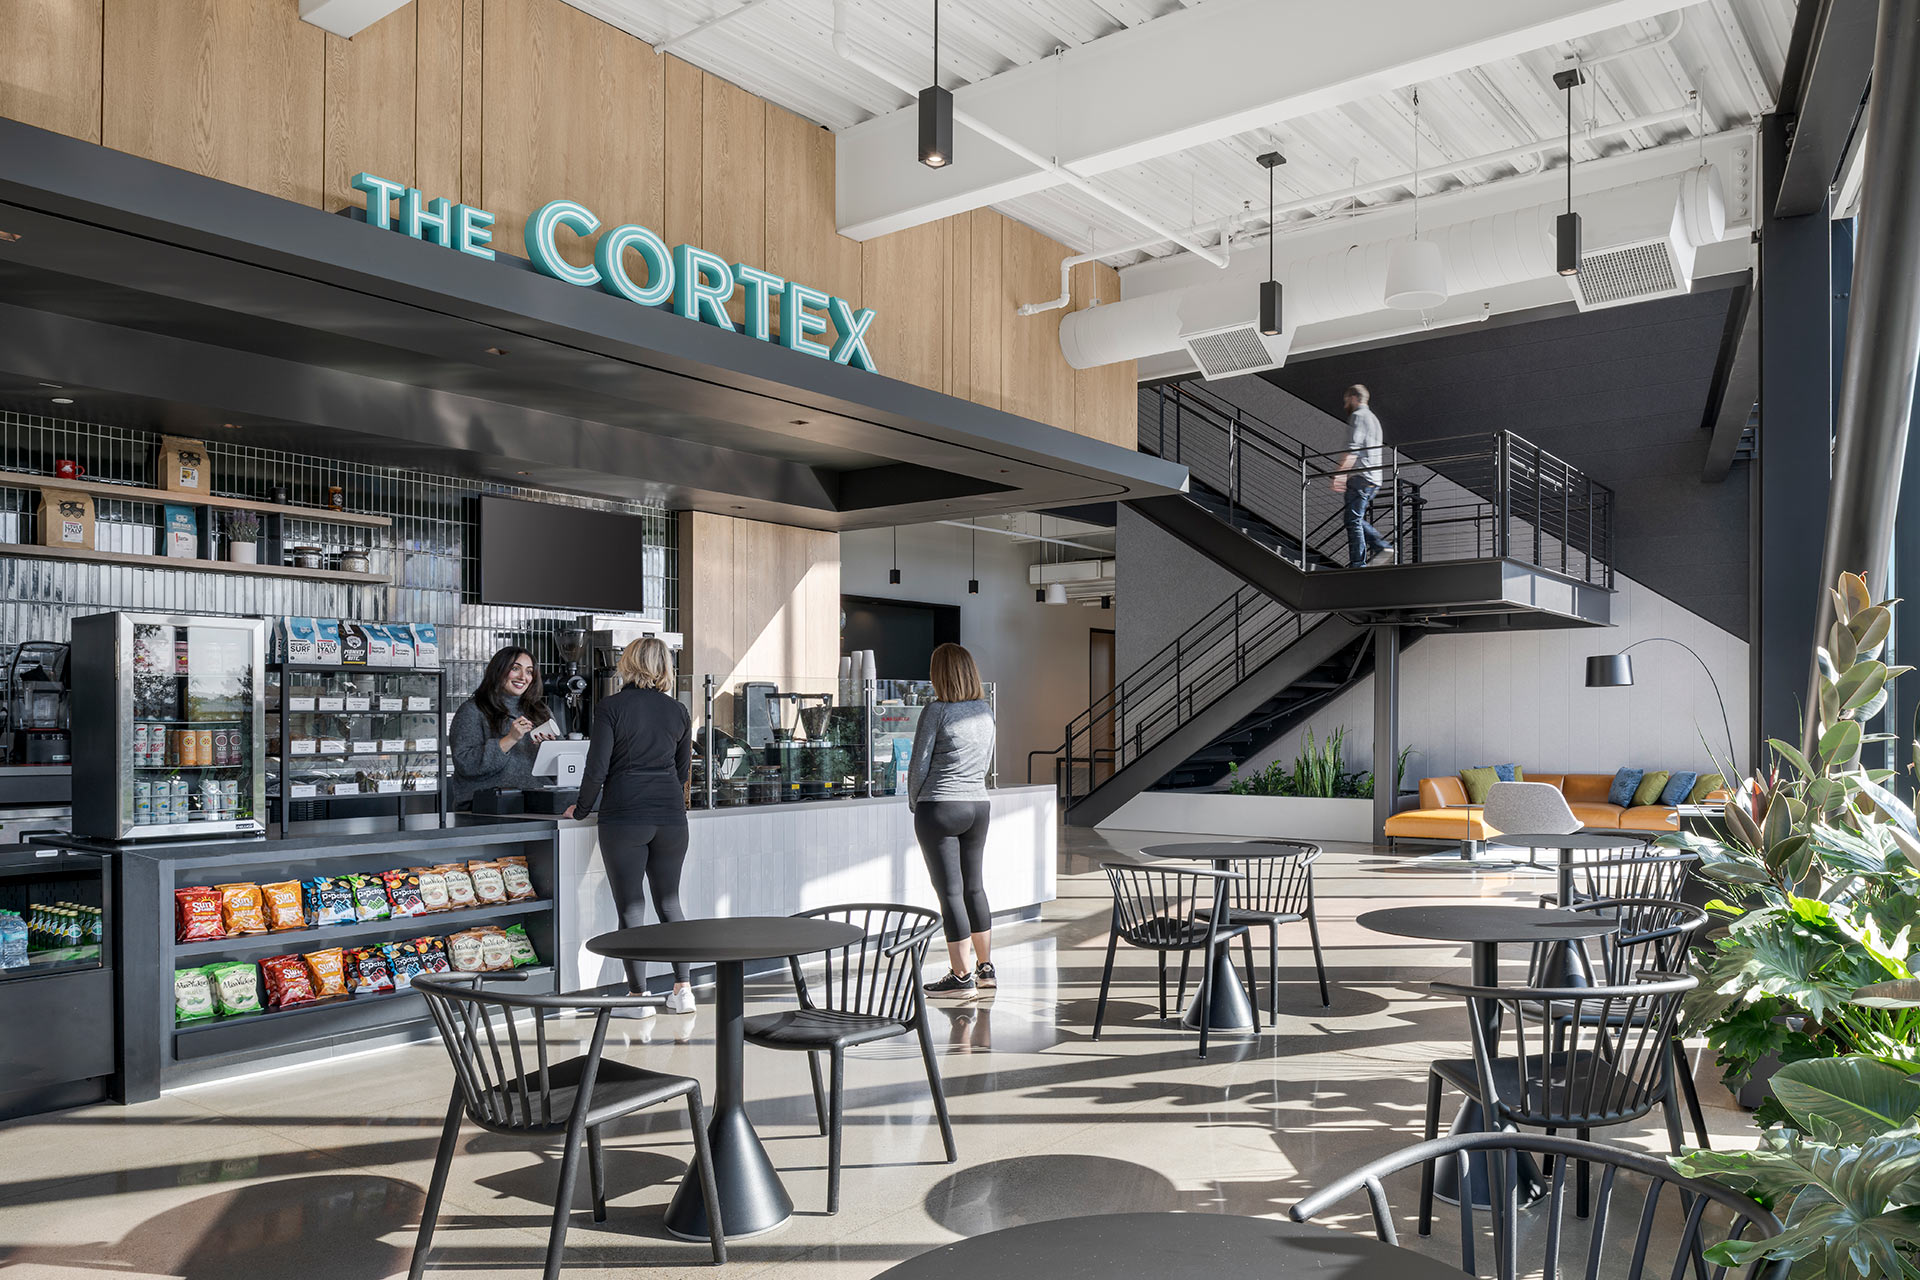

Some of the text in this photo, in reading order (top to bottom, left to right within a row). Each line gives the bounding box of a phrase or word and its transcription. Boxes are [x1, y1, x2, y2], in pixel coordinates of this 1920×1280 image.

[352, 172, 879, 374] THE CORTEX
[290, 645, 311, 653] SURF
[231, 896, 250, 909] Sun
[274, 892, 294, 905] Sun
[192, 900, 212, 913] Sun
